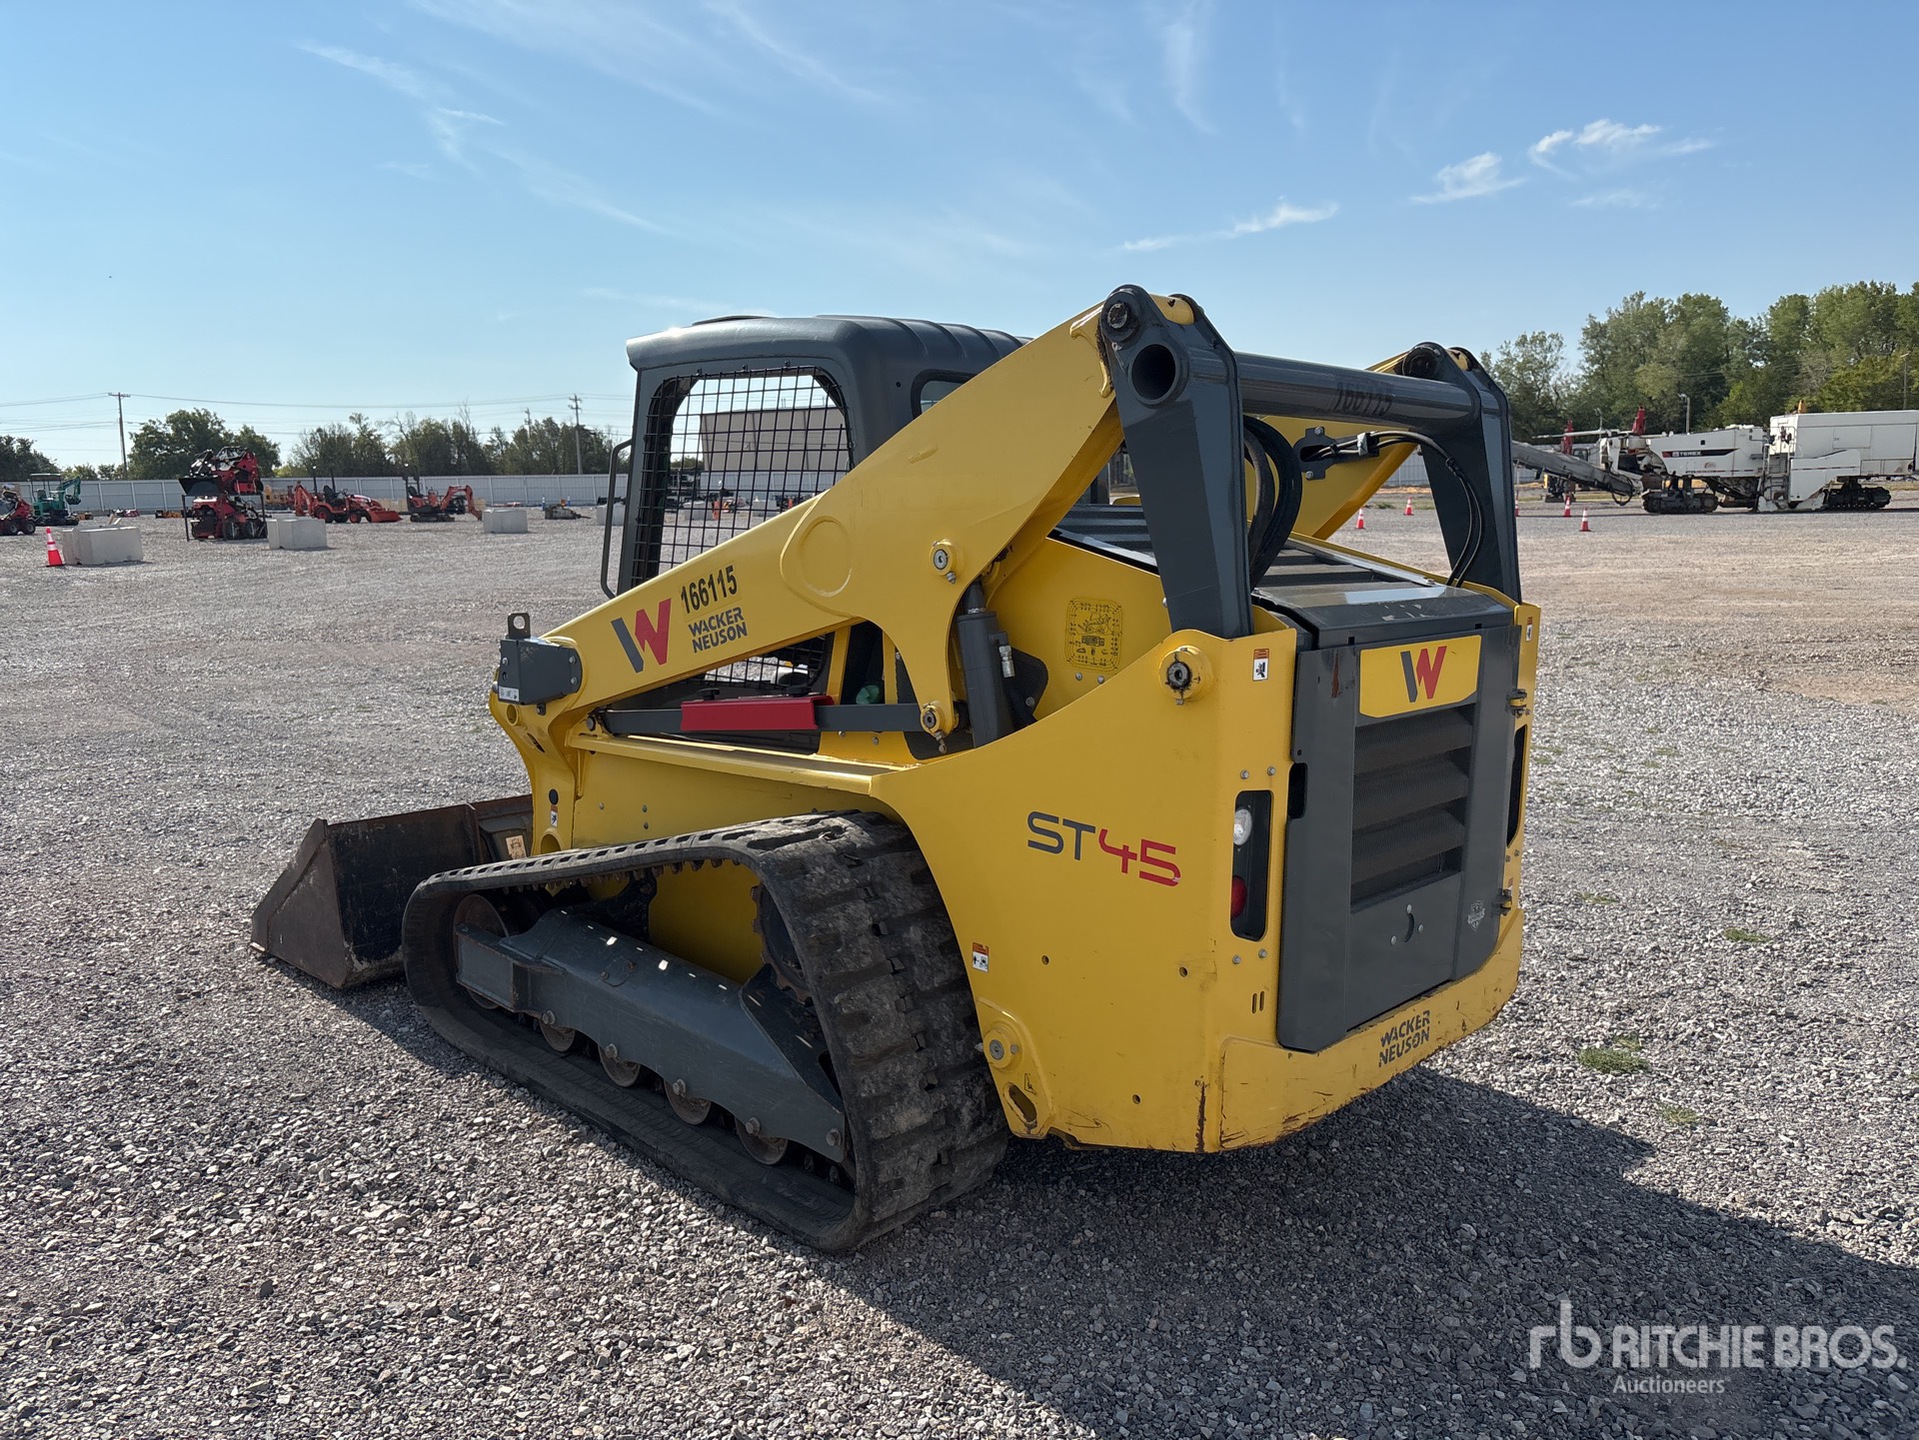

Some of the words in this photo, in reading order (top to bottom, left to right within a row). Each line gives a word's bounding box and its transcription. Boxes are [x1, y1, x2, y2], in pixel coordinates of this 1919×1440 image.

[680, 565, 738, 614] 166115
[688, 606, 745, 637] WACKER
[692, 621, 748, 654] NEUSON
[1027, 811, 1181, 887] ST45
[1378, 1026, 1430, 1068] NEUSON
[1380, 1009, 1431, 1048] WACKER
